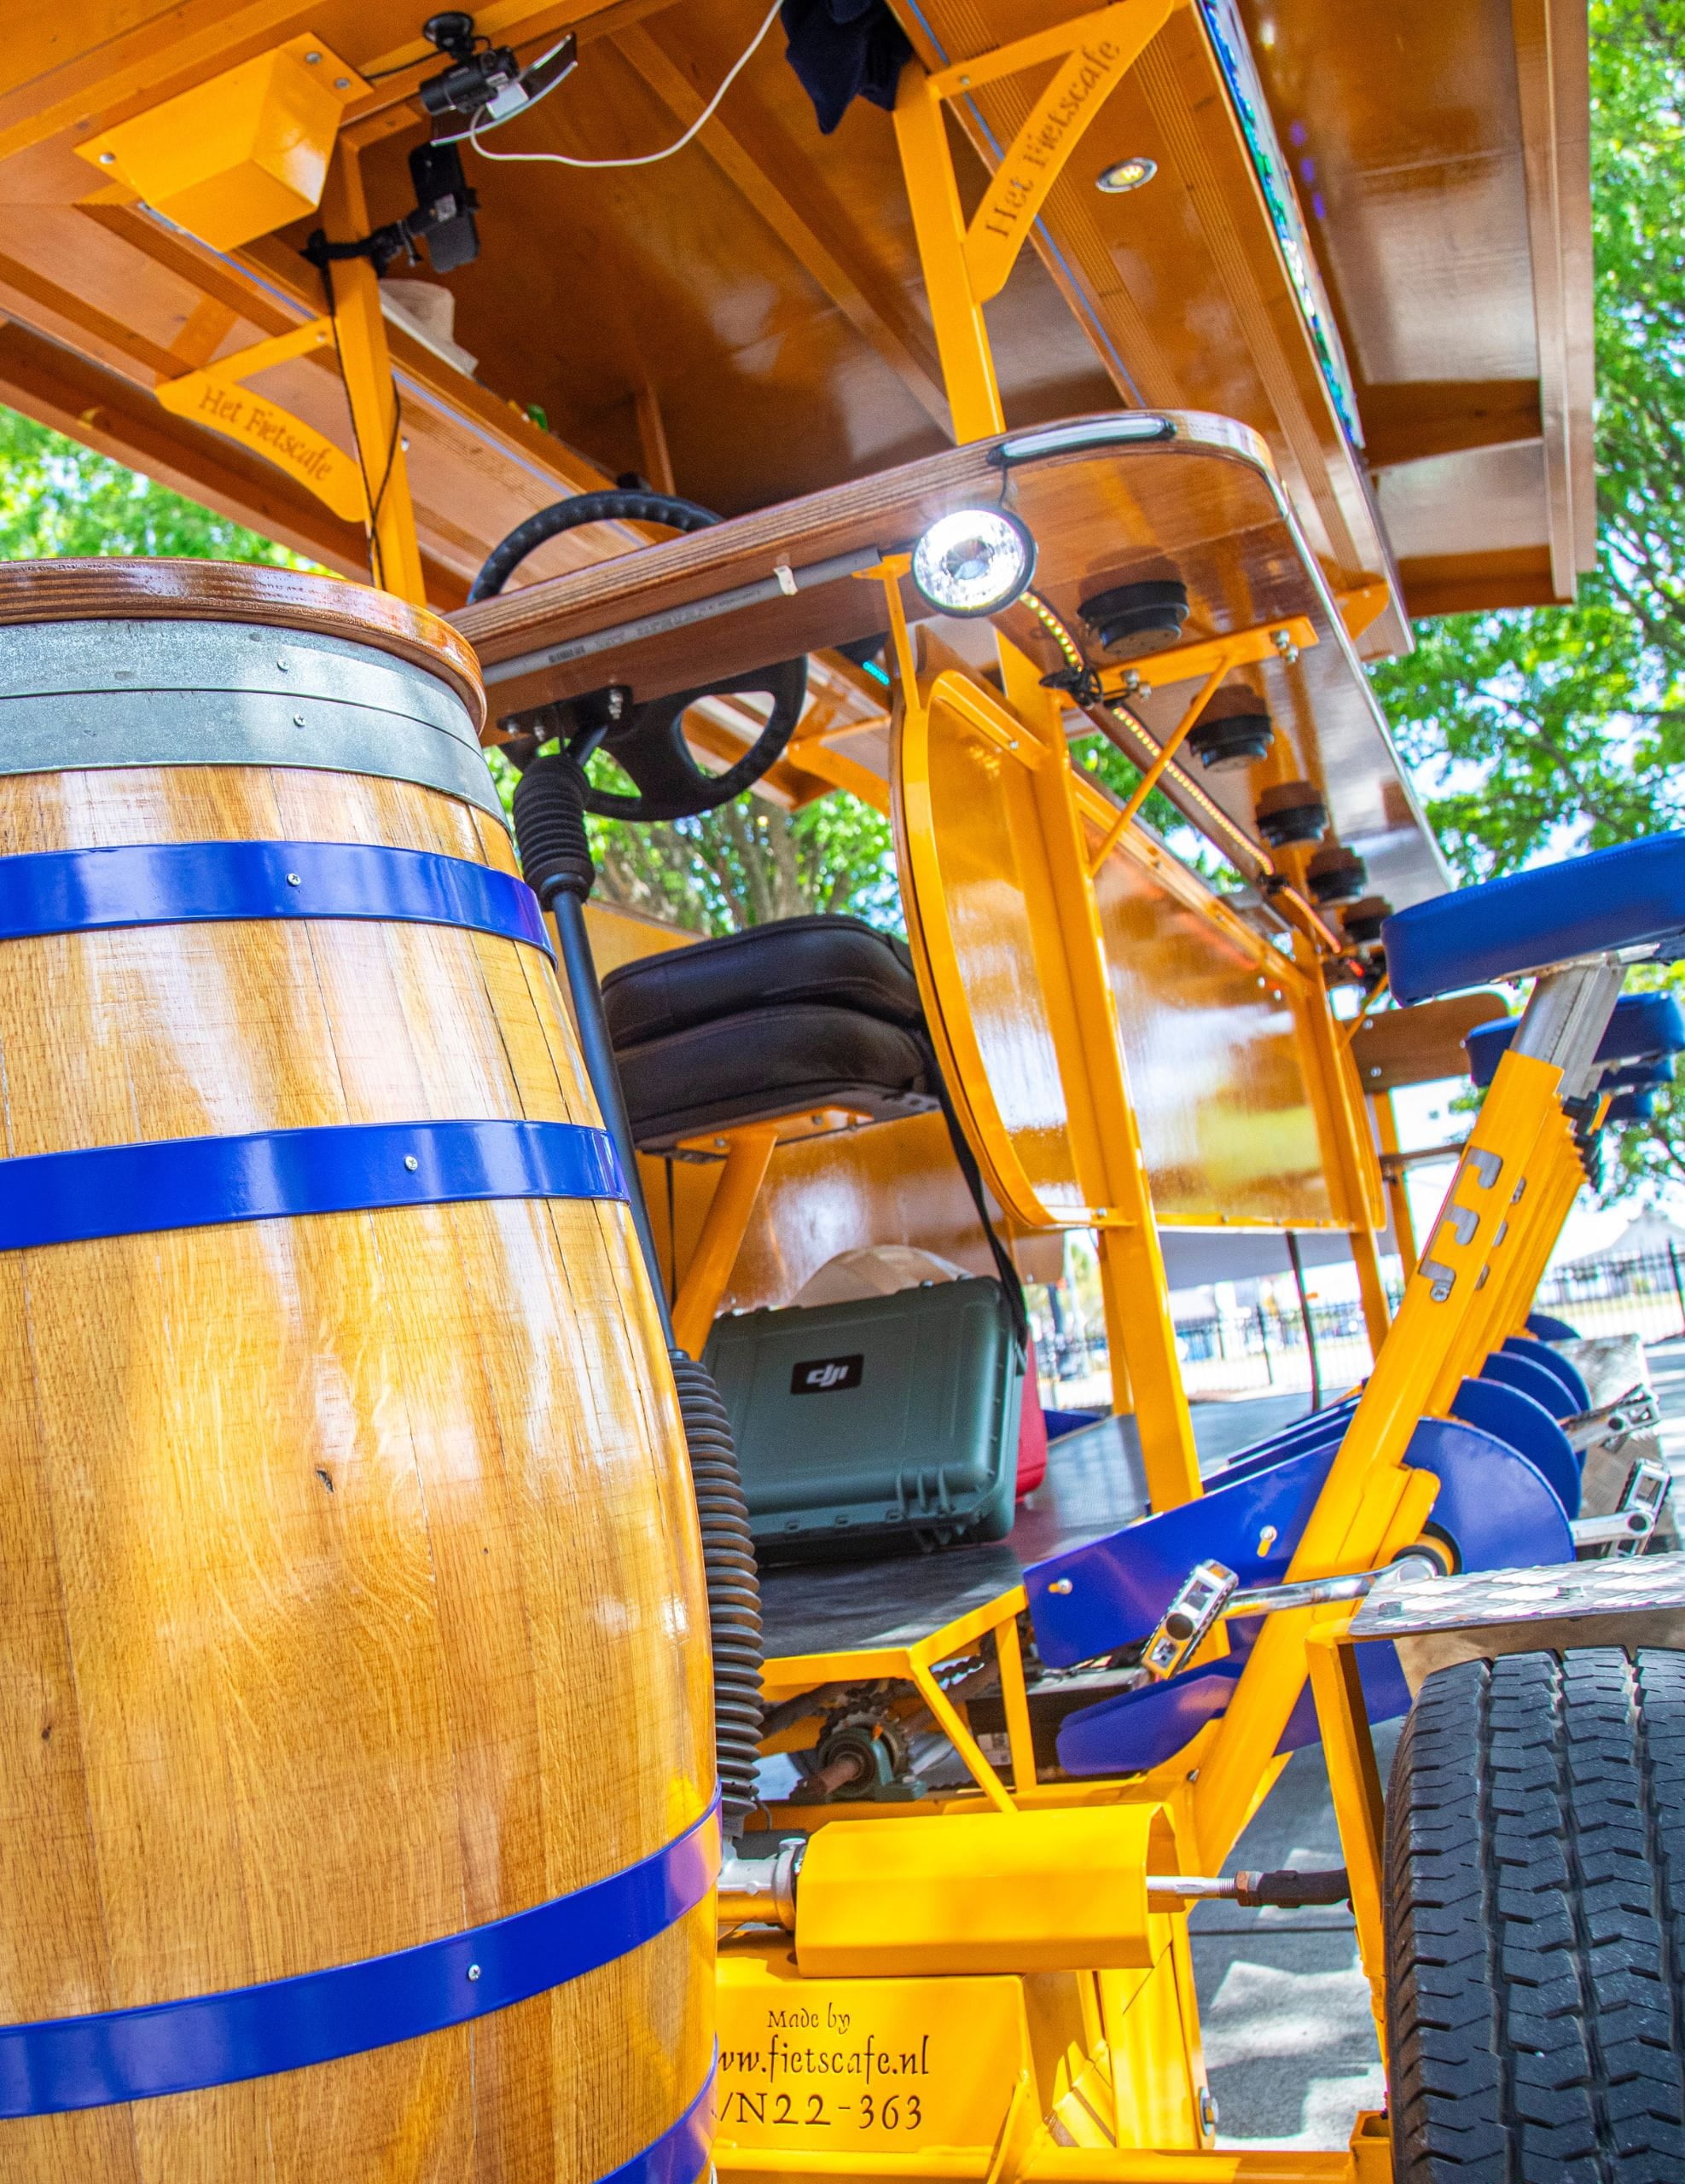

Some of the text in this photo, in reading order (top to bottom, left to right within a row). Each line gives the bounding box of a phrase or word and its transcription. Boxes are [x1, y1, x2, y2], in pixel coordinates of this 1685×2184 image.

[986, 41, 1121, 238] Het Fietscafe
[199, 386, 333, 480] Het Fietscafe
[767, 2002, 851, 2035] Made by
